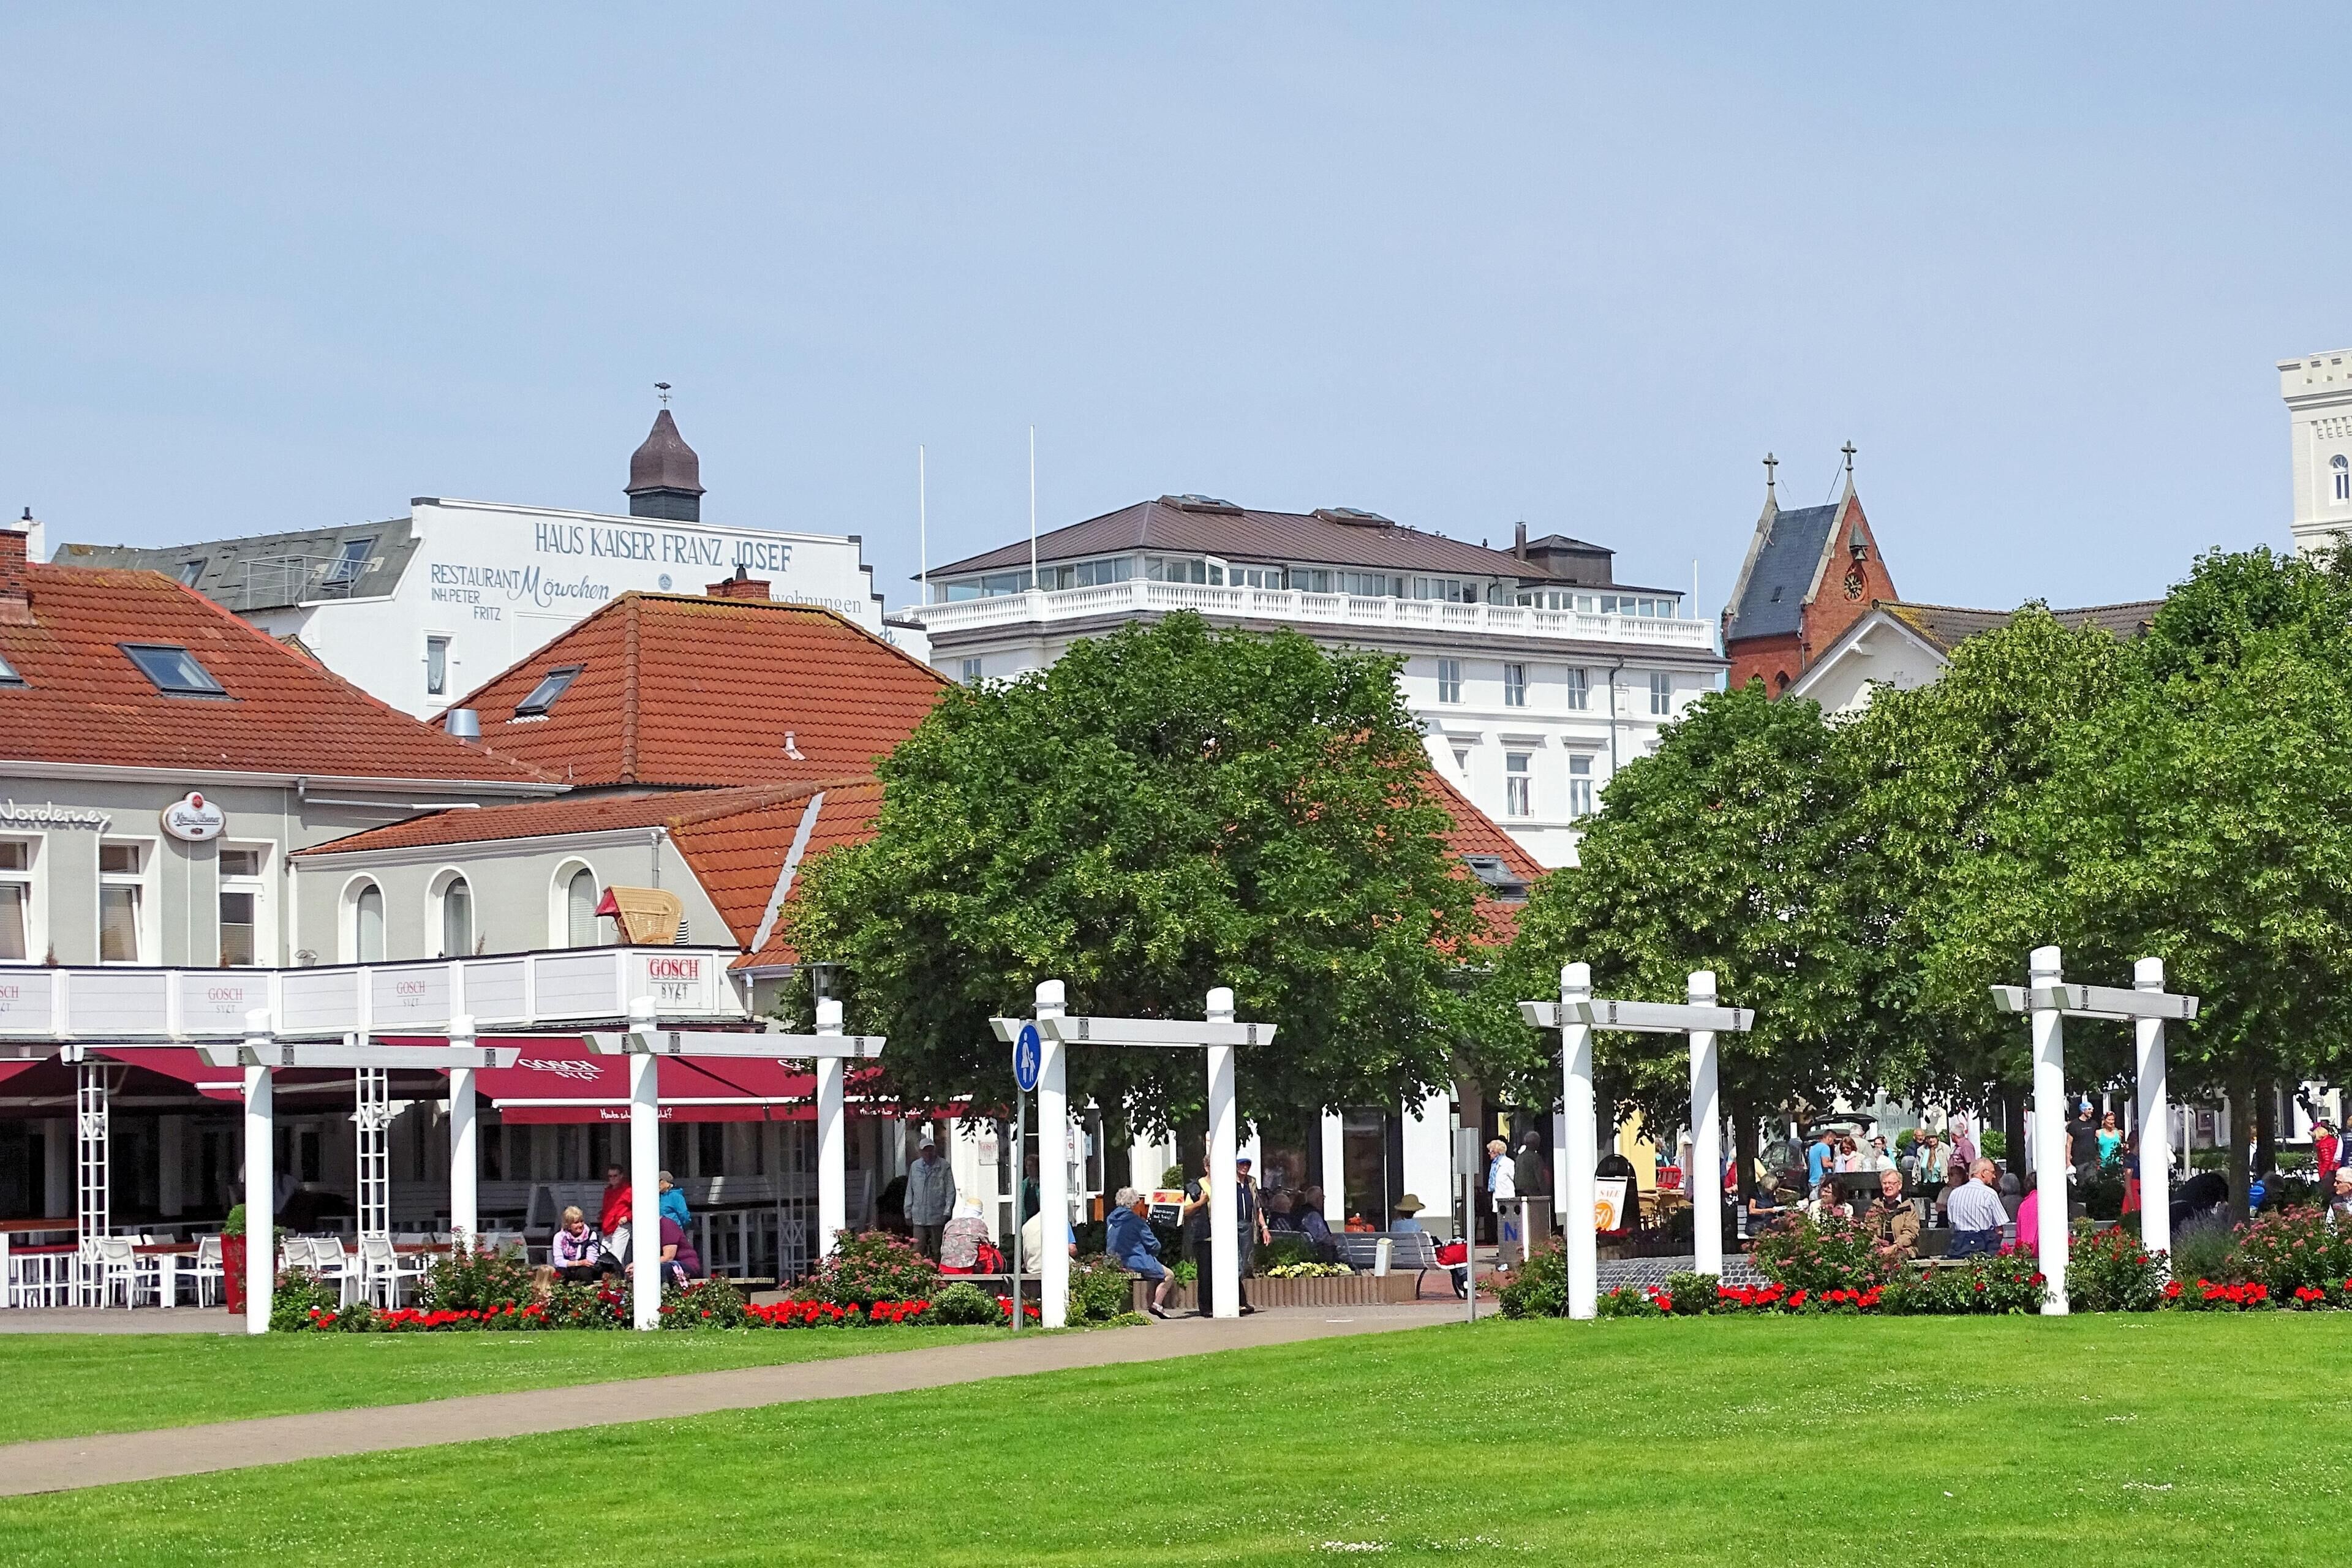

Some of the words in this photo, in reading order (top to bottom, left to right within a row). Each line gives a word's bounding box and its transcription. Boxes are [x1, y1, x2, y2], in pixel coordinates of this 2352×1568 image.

[535, 522, 584, 555] HAUS
[590, 528, 656, 562] KAISER
[662, 534, 723, 567] FRANZ
[731, 541, 793, 572] JOSEF
[431, 564, 521, 589] RESTAURANT
[473, 606, 502, 621] FRITZ
[0, 797, 112, 831] Norderney
[650, 958, 699, 980] GOSCH
[208, 988, 243, 1000] GOSCH
[396, 981, 425, 994] GOSCH
[518, 1058, 601, 1071] GOSCH
[1504, 1222, 1517, 1242] N
